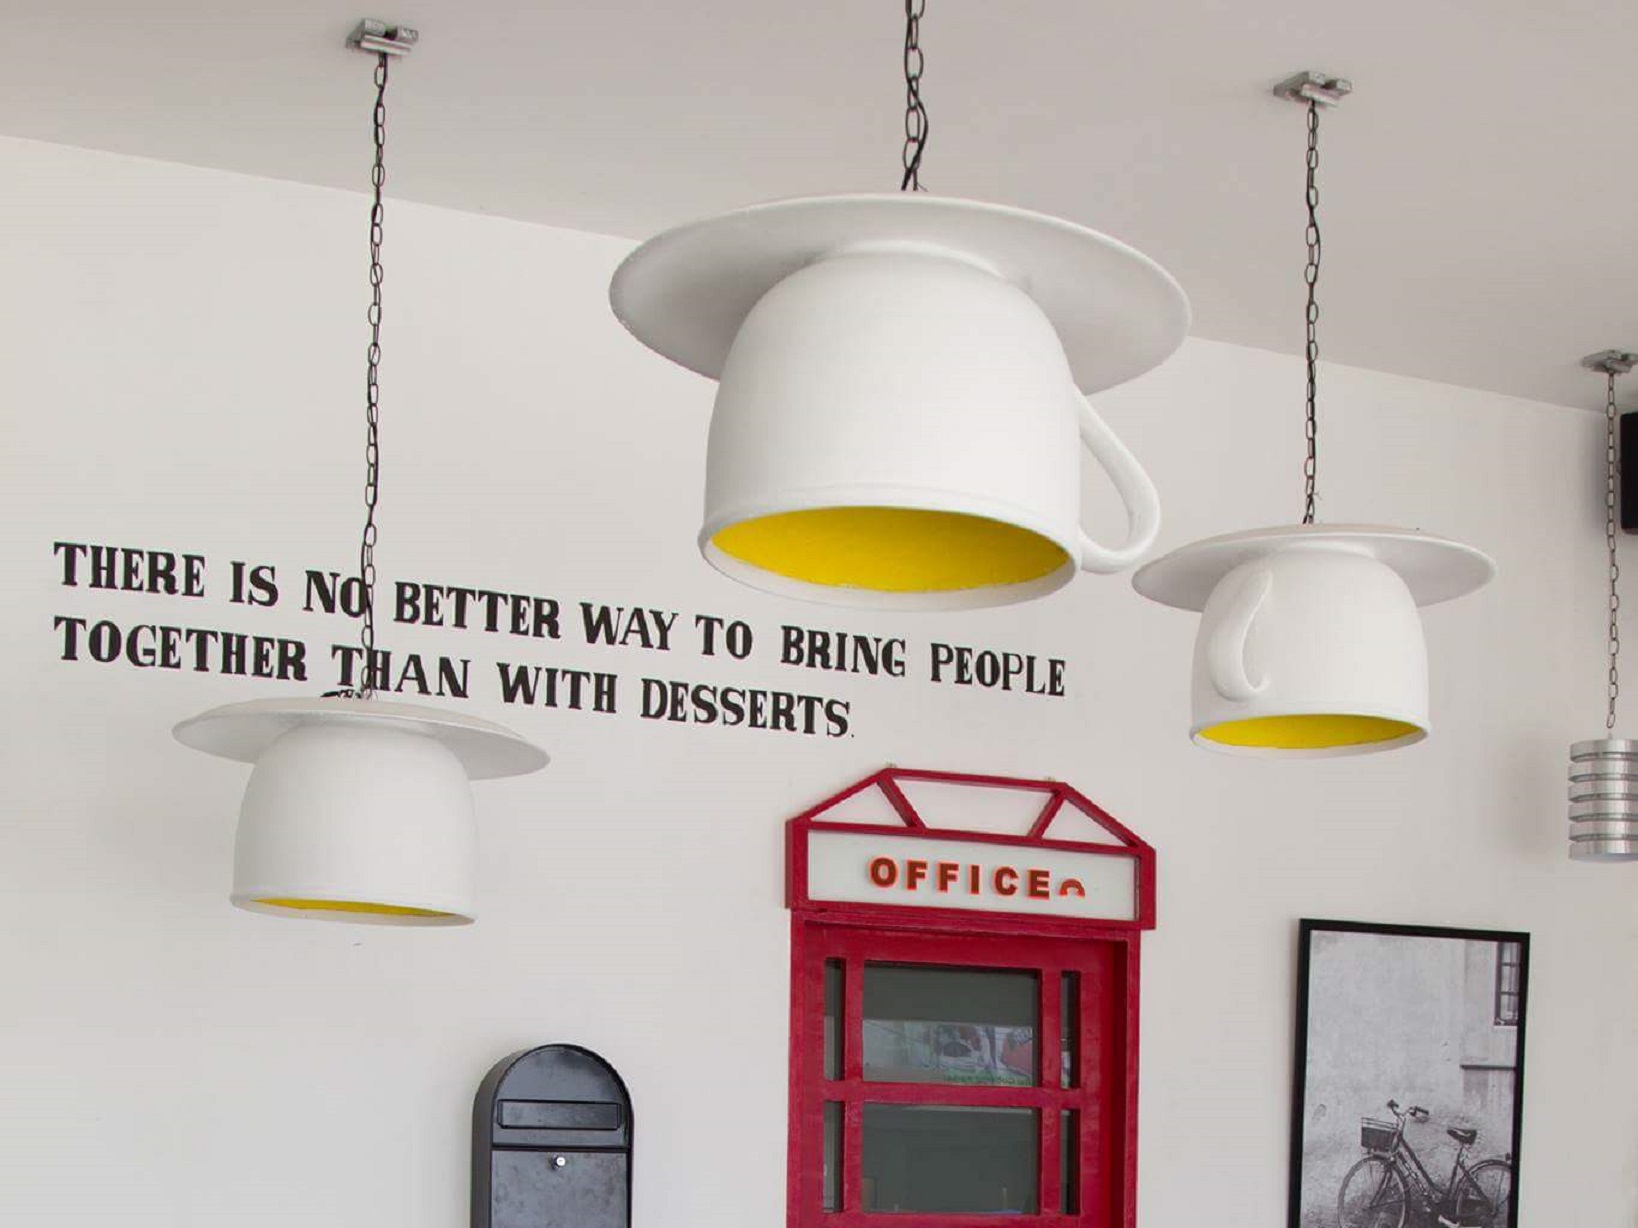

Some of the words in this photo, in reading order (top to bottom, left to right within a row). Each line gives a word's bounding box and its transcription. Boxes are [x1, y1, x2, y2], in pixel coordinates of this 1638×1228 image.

[53, 615, 308, 682] TOGETHER
[331, 644, 471, 699] THAN
[496, 661, 618, 714] WITH
[54, 541, 206, 598] THERE
[229, 560, 279, 607] IS
[302, 569, 369, 618] NO
[393, 581, 561, 640] BETTER
[579, 601, 679, 651] WAY
[695, 614, 753, 660] TO
[780, 625, 906, 678] BRING
[930, 642, 1066, 697] PEOPLE
[868, 855, 1051, 900] OFFICE
